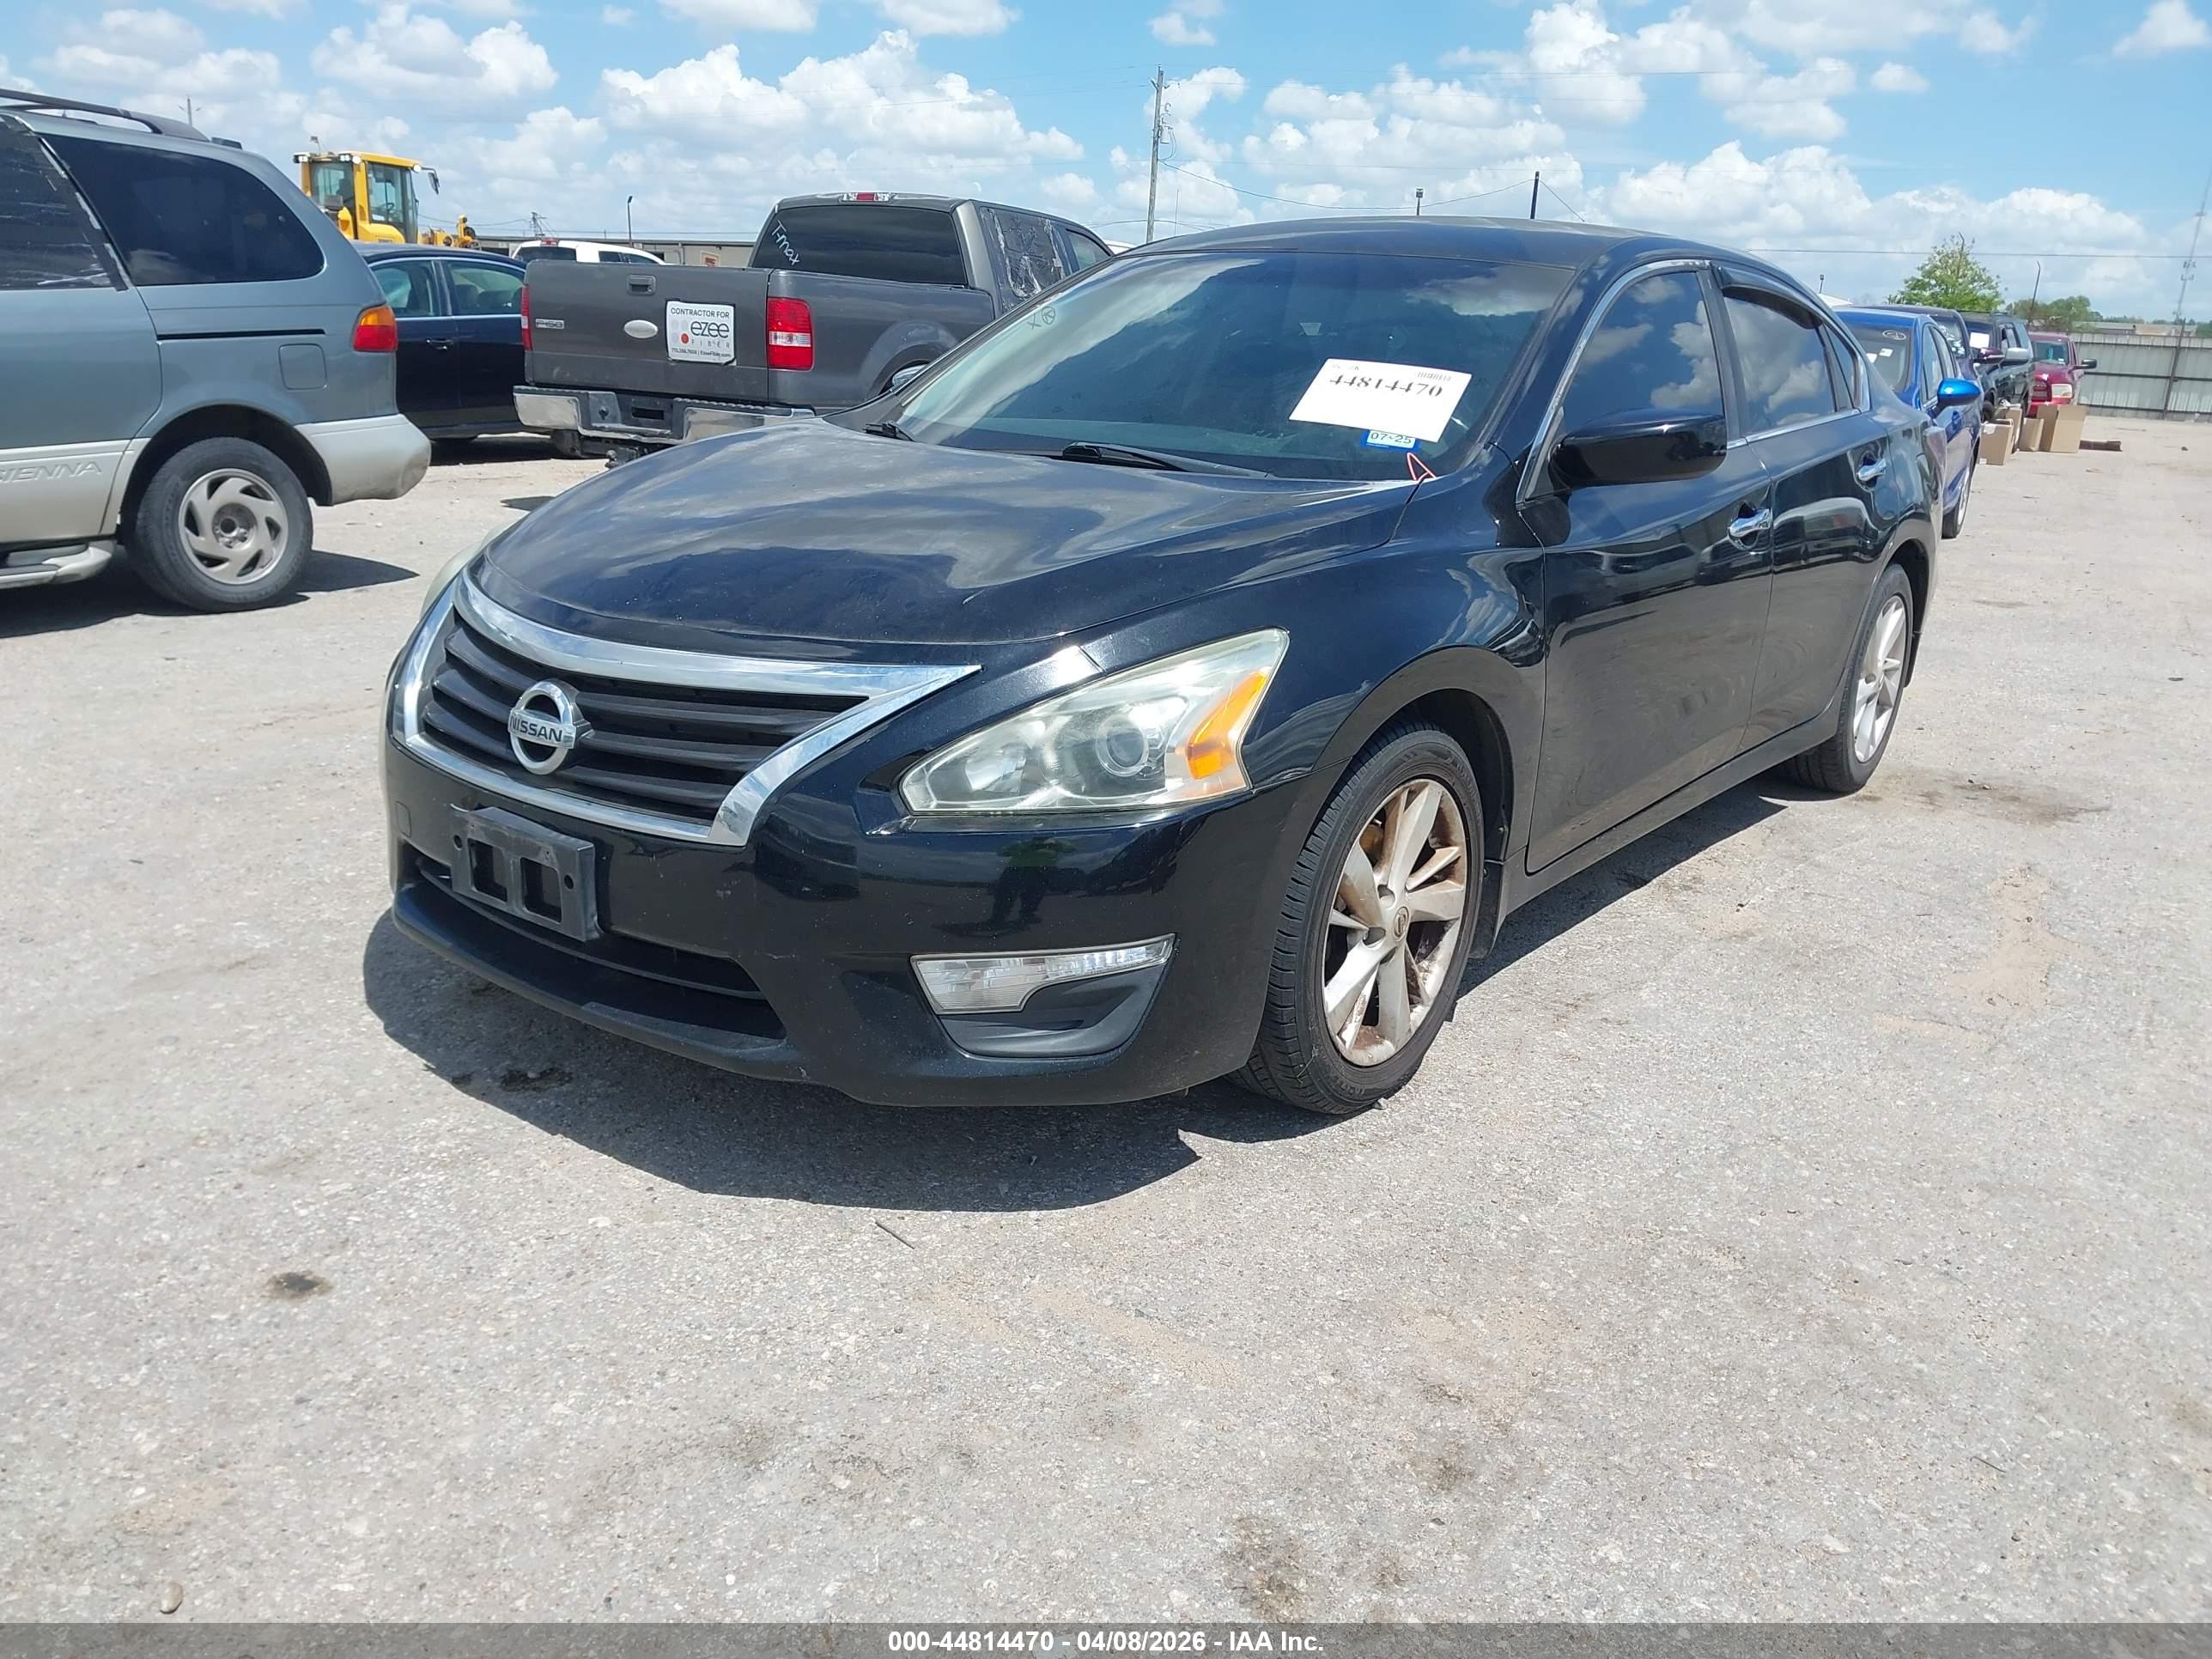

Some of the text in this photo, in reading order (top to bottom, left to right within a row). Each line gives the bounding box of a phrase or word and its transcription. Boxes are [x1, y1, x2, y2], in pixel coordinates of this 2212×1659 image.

[671, 307, 715, 317] CONTRACTOR
[690, 320, 730, 338] ezee
[691, 338, 730, 349] FIBER
[1329, 374, 1443, 397] 44814470
[509, 715, 563, 743] NISSAN
